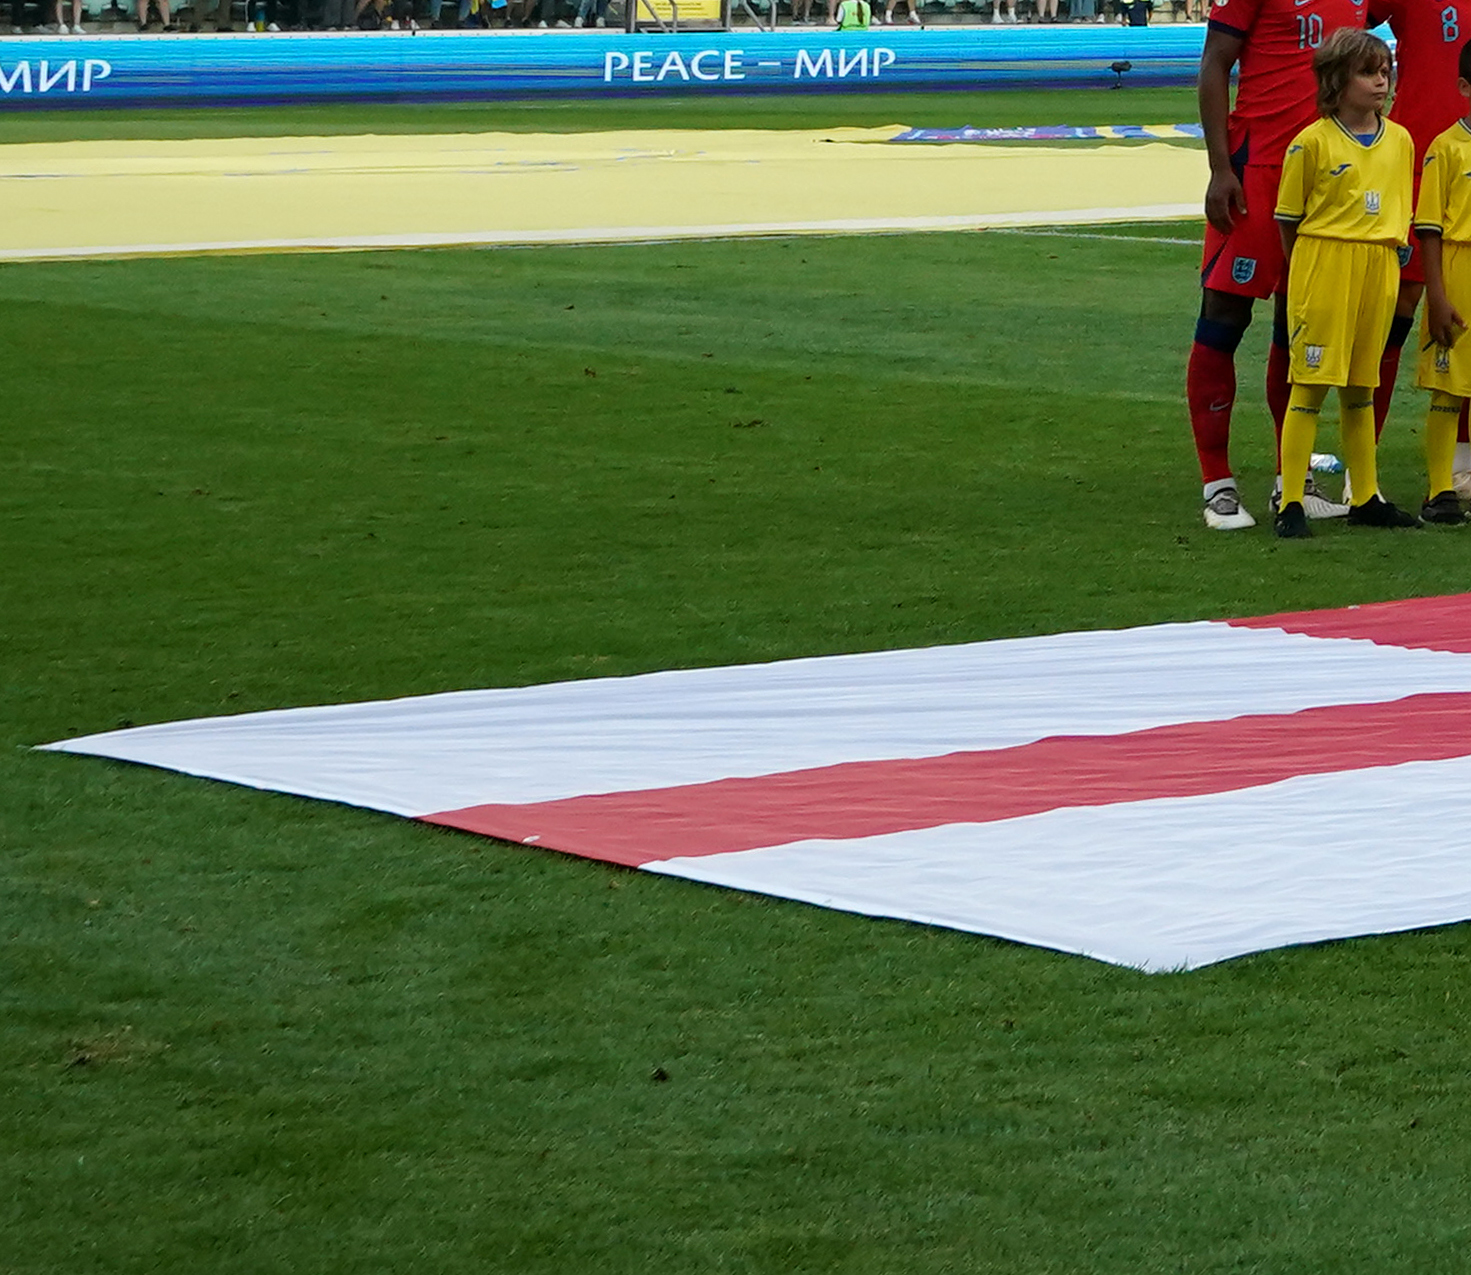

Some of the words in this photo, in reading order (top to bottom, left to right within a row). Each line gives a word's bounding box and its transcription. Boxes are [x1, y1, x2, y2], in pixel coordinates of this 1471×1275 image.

[1296, 13, 1323, 50] 10
[1441, 5, 1460, 43] 8
[604, 50, 746, 82] PEACE
[793, 47, 897, 79] МИР
